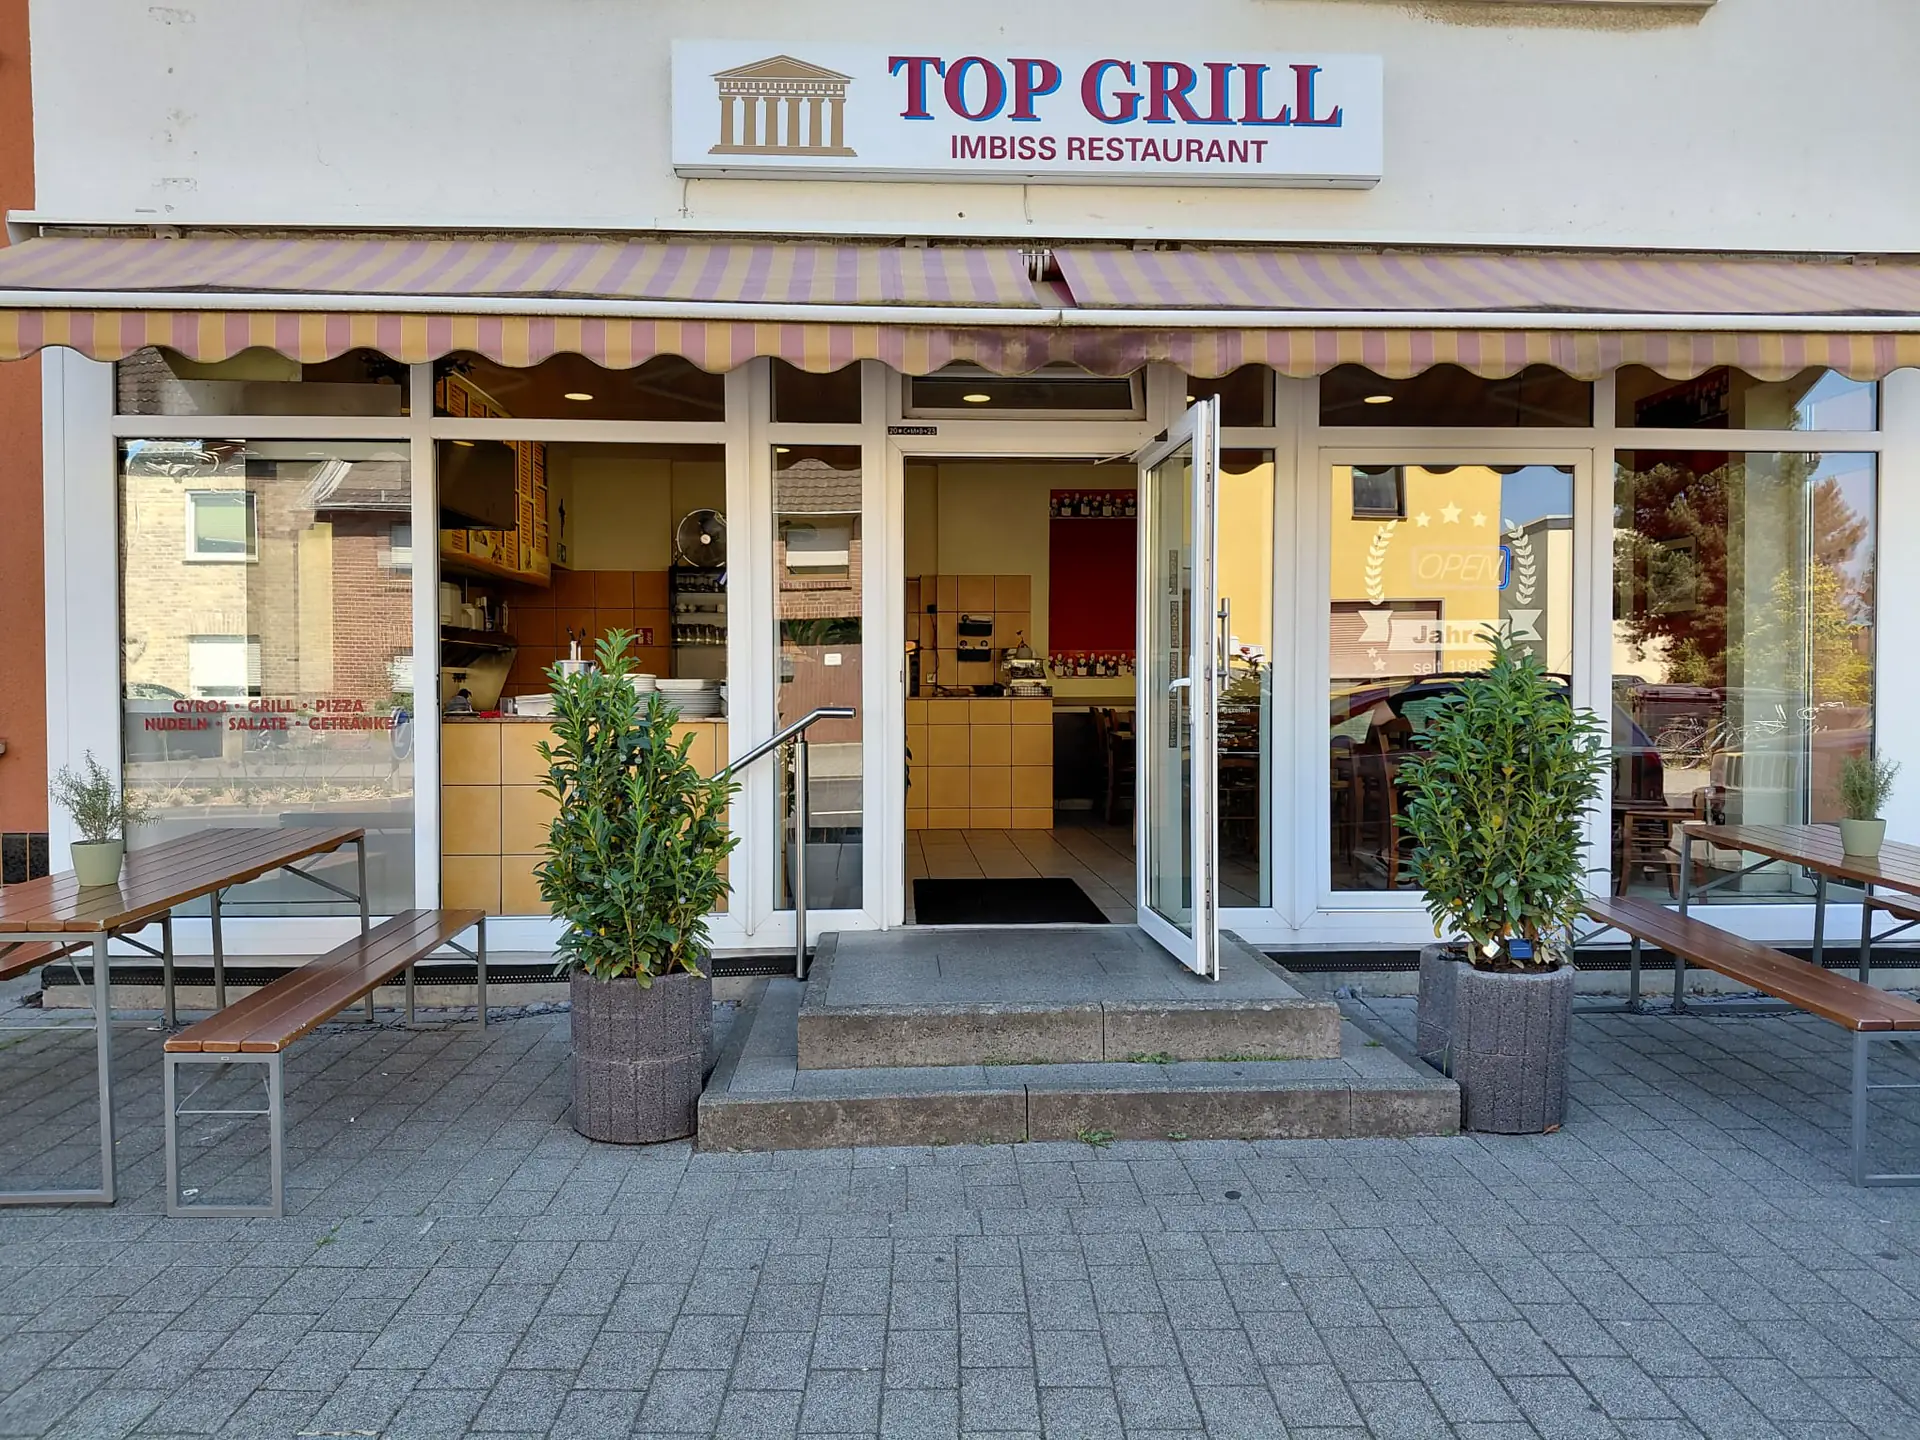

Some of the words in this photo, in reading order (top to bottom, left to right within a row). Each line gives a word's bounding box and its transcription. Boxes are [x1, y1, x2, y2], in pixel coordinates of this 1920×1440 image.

[888, 55, 1061, 122] TOP
[1081, 59, 1343, 127] GRILL
[950, 135, 1057, 161] IMBISS
[1067, 138, 1268, 164] RESTAURANT
[1417, 553, 1505, 581] OPEN
[1413, 659, 1442, 673] seit
[173, 700, 228, 713] GYROS
[248, 700, 296, 713] GRILL
[315, 700, 365, 712] PIZZA
[145, 717, 209, 731] NUDELN
[229, 717, 288, 731] SALATE
